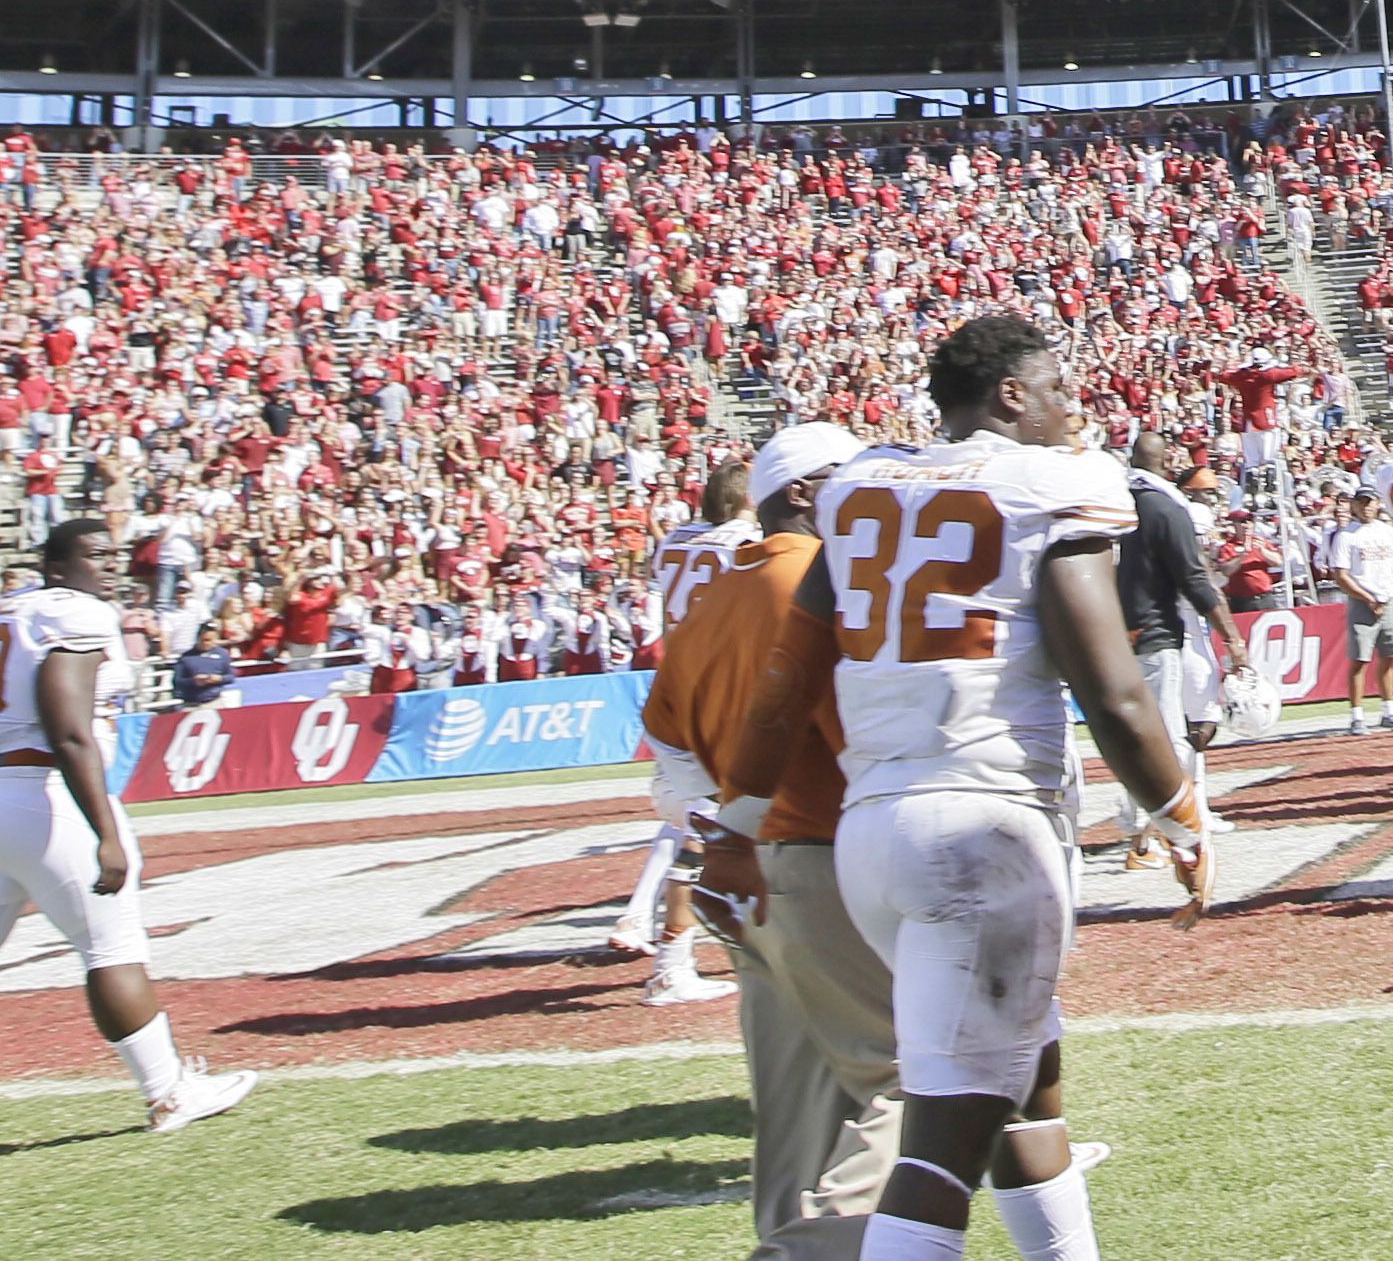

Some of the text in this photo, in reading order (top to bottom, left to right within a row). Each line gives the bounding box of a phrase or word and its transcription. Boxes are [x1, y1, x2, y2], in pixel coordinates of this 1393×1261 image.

[834, 487, 1005, 663] 32
[1251, 610, 1321, 699] OU
[163, 709, 232, 793] OU
[291, 697, 360, 783] OU
[486, 700, 605, 746] AT&T
